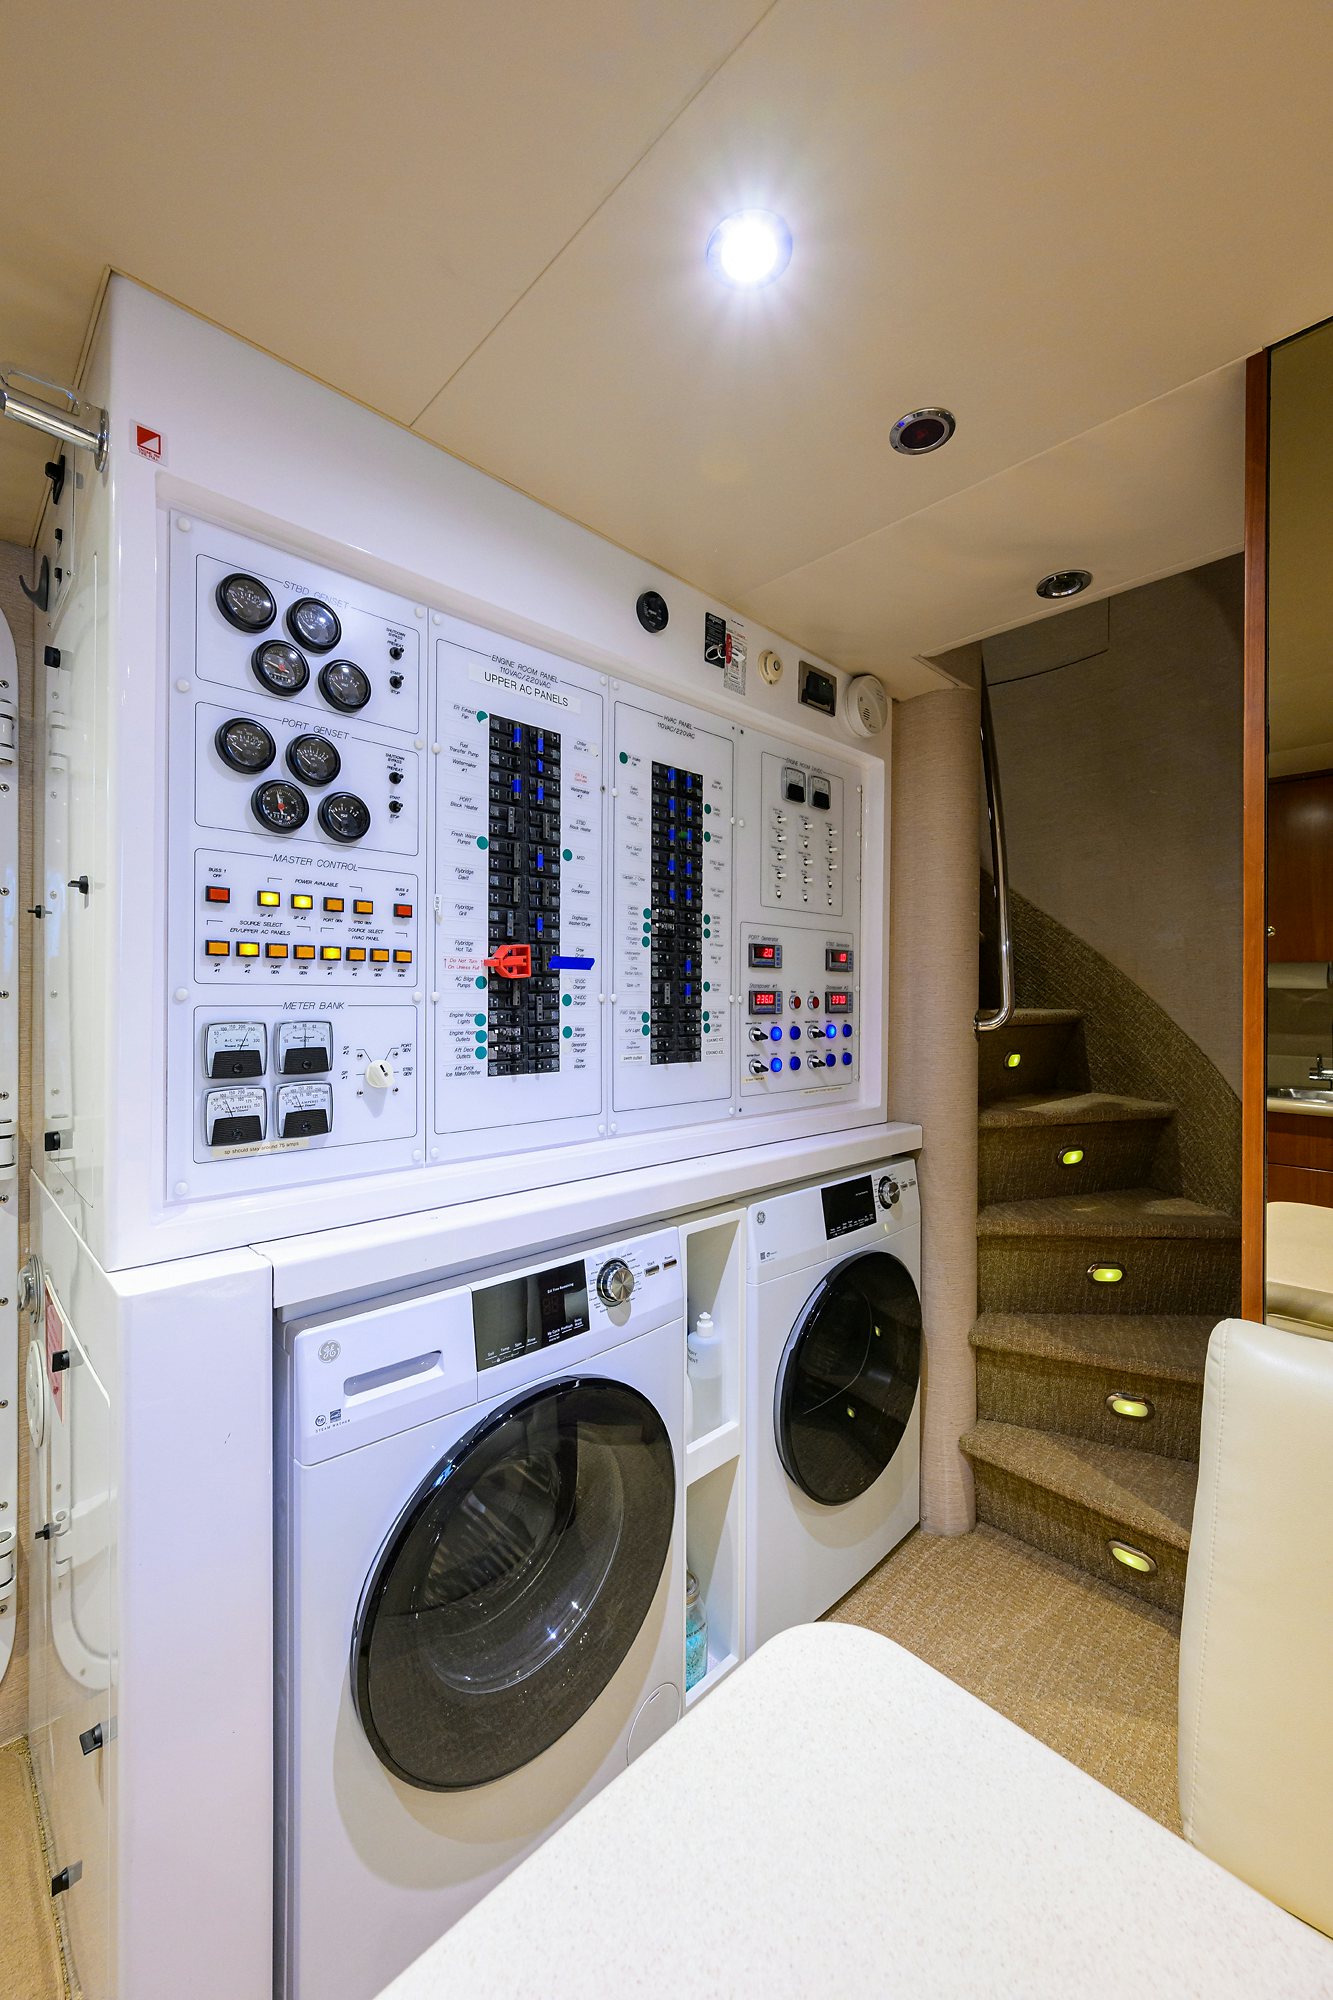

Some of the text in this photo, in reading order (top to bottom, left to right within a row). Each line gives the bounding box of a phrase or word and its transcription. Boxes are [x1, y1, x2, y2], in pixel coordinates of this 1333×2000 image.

[283, 580, 349, 609] STBD GENSET
[491, 654, 559, 683] ENGINE ROOM PANEL
[500, 666, 551, 689] 110VAC/220VAC
[484, 672, 568, 707] UPPER AC PANELS
[461, 706, 477, 715] Exhaust
[282, 718, 349, 740] PORT GENSET
[664, 716, 692, 729] HVAC PANEL
[657, 722, 695, 739] 110VAC/220VAC
[449, 746, 466, 755] Transfer
[453, 759, 477, 769] Watermaker
[273, 854, 357, 871] MASTER CONTROL
[455, 867, 474, 875] Flybridge
[283, 1002, 345, 1010] METER BANK
[333, 1419, 350, 1427] WASHER
